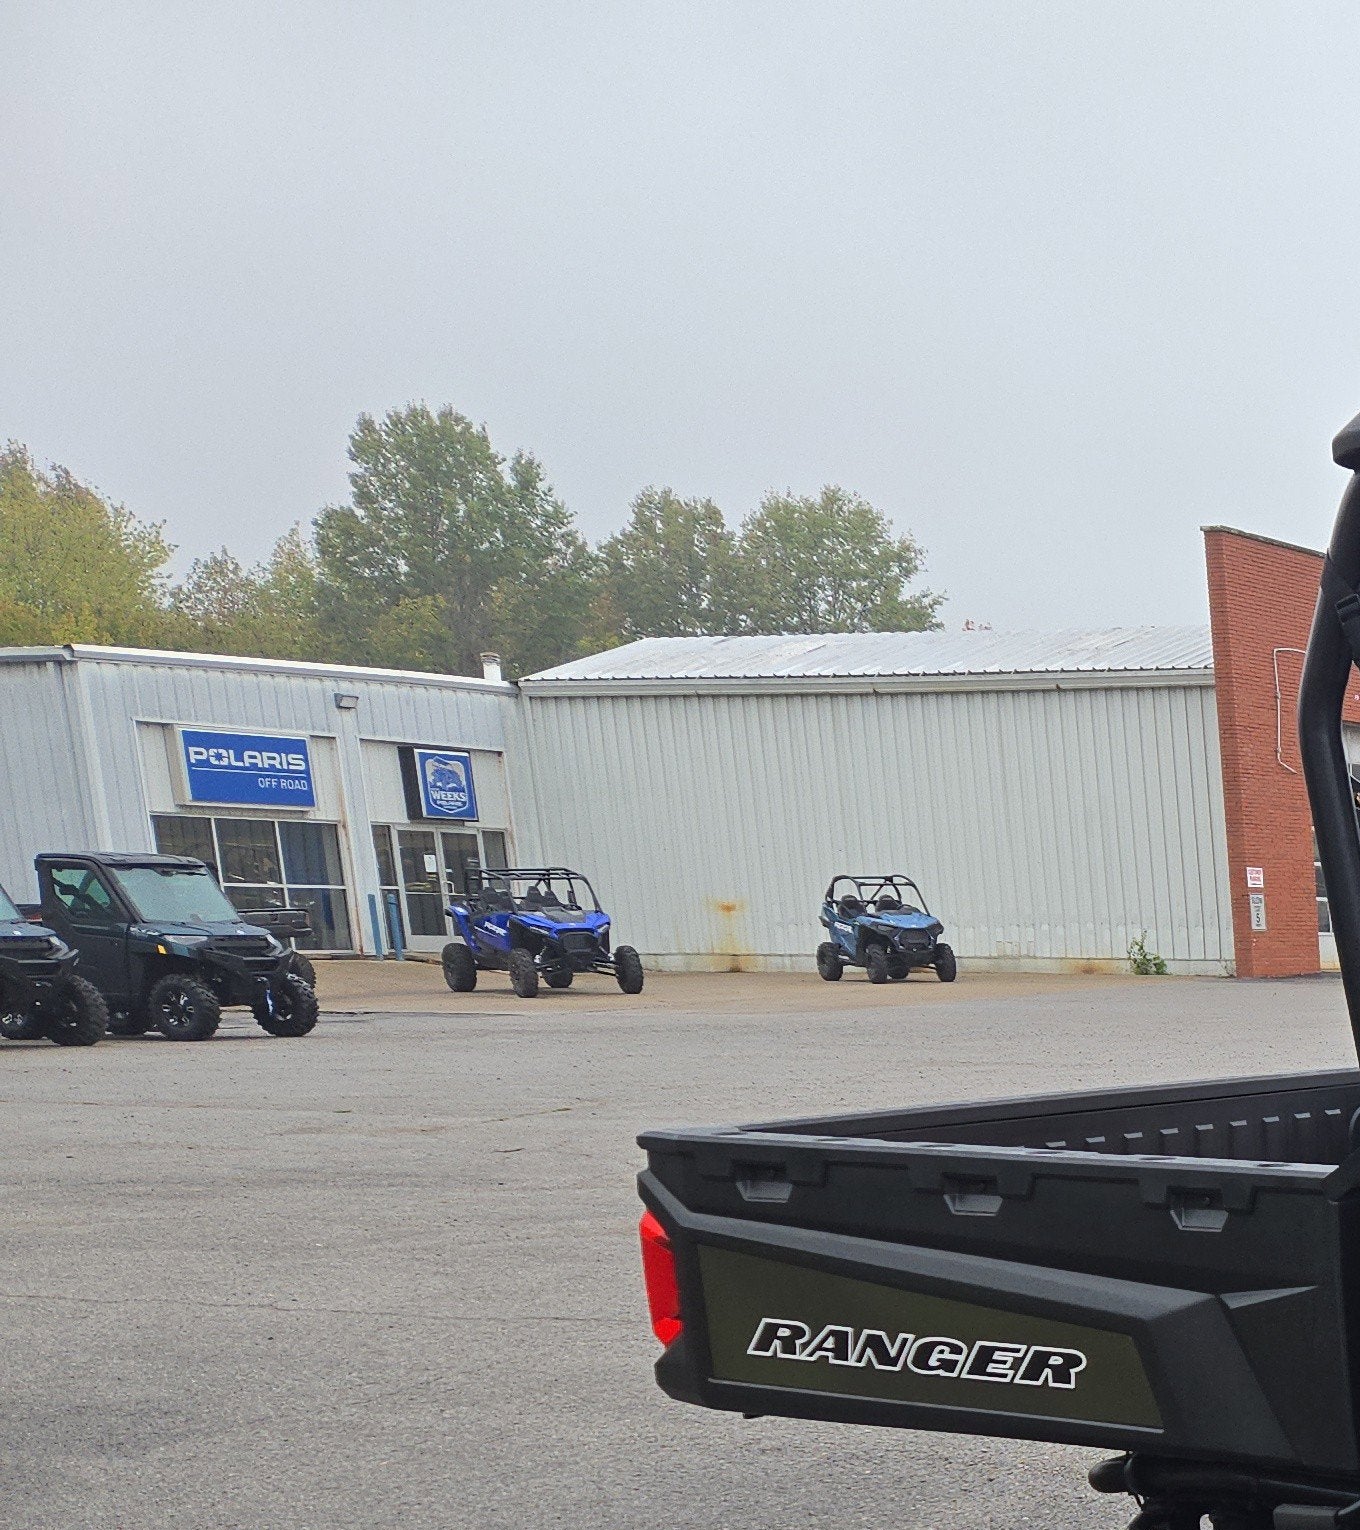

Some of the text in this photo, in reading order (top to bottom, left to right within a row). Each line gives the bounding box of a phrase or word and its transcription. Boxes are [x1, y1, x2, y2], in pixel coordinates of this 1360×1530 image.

[188, 746, 306, 771] POLARIS
[258, 777, 308, 790] OFF ROAD
[430, 789, 468, 801] WEEKS
[747, 1317, 1087, 1389] RANGER
